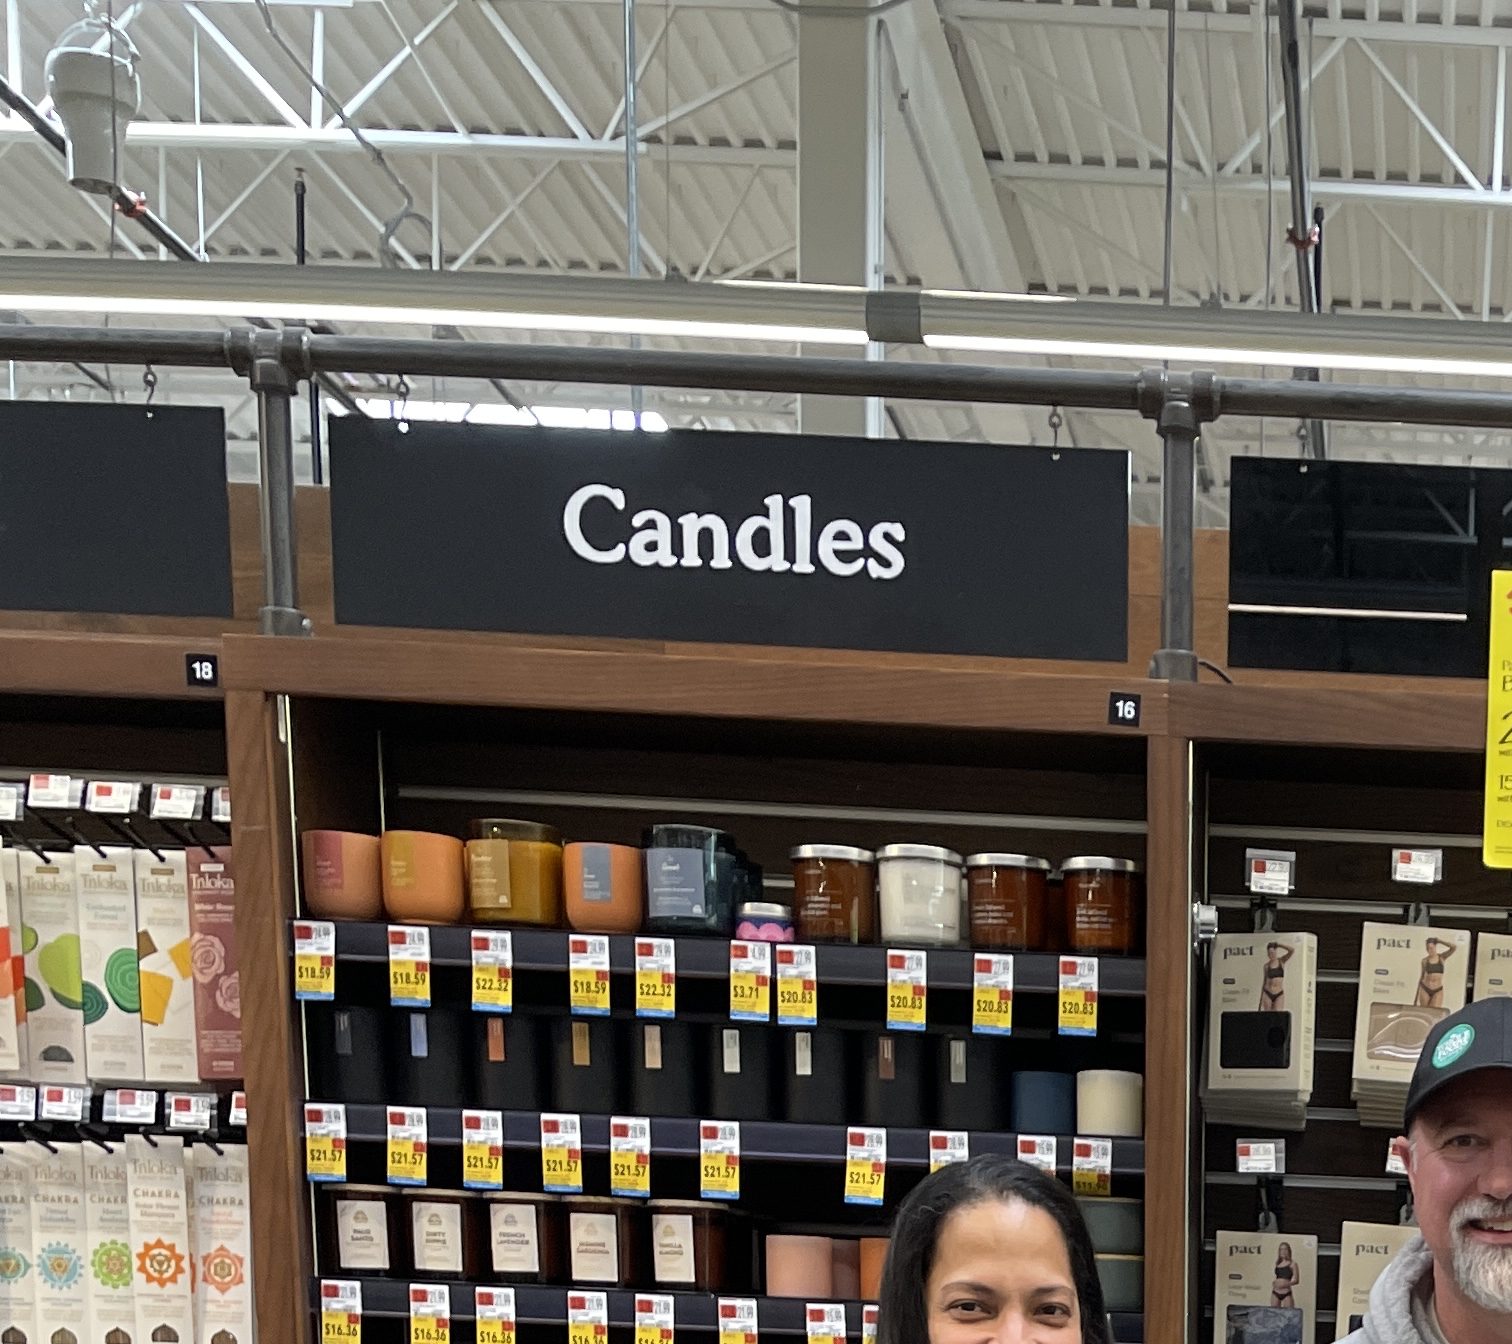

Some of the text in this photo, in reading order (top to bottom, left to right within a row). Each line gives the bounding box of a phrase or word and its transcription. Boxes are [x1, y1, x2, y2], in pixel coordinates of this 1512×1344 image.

[562, 483, 907, 580] Candles
[191, 661, 213, 681] 18
[1114, 701, 1136, 721] 16
[1376, 937, 1412, 951] pact
[1223, 944, 1254, 961] pact
[298, 966, 331, 980] $18.59
[392, 971, 426, 986] $18.59
[475, 978, 510, 992] $22.32
[573, 980, 607, 994] $18.59
[639, 982, 672, 997] $22.32
[733, 985, 760, 999] $3.71
[780, 990, 814, 1004] $20.83
[890, 994, 923, 1009] $20.83
[976, 999, 1009, 1014] $20.83
[1062, 1001, 1094, 1016] $20.83
[309, 1149, 343, 1163] $21.57
[390, 1151, 424, 1166] $21.57
[466, 1155, 500, 1170] $21.57
[545, 1159, 579, 1173] $21.57
[613, 1163, 647, 1178] $21.57
[703, 1165, 736, 1180] $21.57
[849, 1171, 882, 1186] $21.57
[133, 1188, 180, 1199] CHAKRA
[1228, 1243, 1263, 1256] pact
[1355, 1243, 1389, 1256] pact
[324, 1323, 358, 1337] $16.36
[413, 1327, 447, 1342] $16.36
[479, 1330, 512, 1344] $16.36
